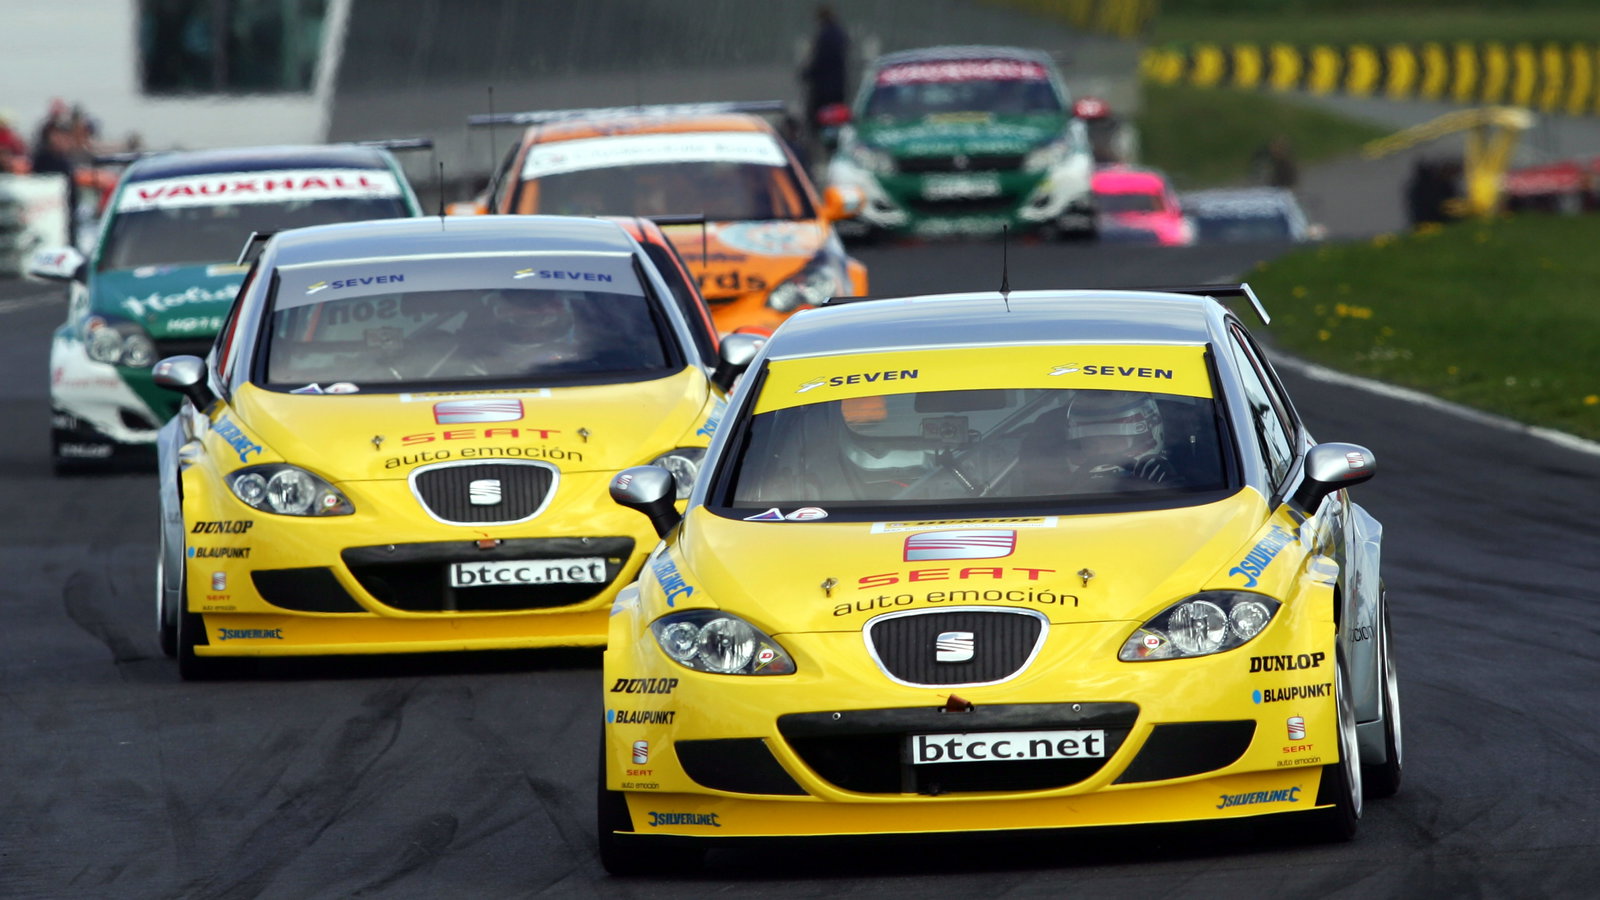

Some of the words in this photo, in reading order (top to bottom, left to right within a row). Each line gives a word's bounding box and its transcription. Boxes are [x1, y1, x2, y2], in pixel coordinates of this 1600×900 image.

[137, 175, 381, 201] VAUXHALL
[331, 274, 405, 290] SEVEN
[539, 270, 613, 283] SEVEN
[829, 369, 919, 387] SEVEN
[1082, 365, 1173, 380] SEVEN
[401, 428, 562, 447] SEAT
[384, 449, 451, 470] auto
[460, 444, 583, 463] emoción
[190, 520, 254, 534] DUNLOP
[196, 546, 251, 559] BLAUPUNKT
[455, 562, 603, 586] btcc.net
[858, 567, 1056, 590] SEAT
[833, 592, 914, 617] auto
[926, 587, 1079, 608] emoción
[1249, 652, 1325, 673] DUNLOP
[610, 677, 679, 694] DUNLOP
[1263, 683, 1332, 703] BLAUPUNKT
[616, 710, 676, 725] BLAUPUNKT
[918, 733, 1100, 762] btcc.net
[1282, 744, 1314, 753] SEAT
